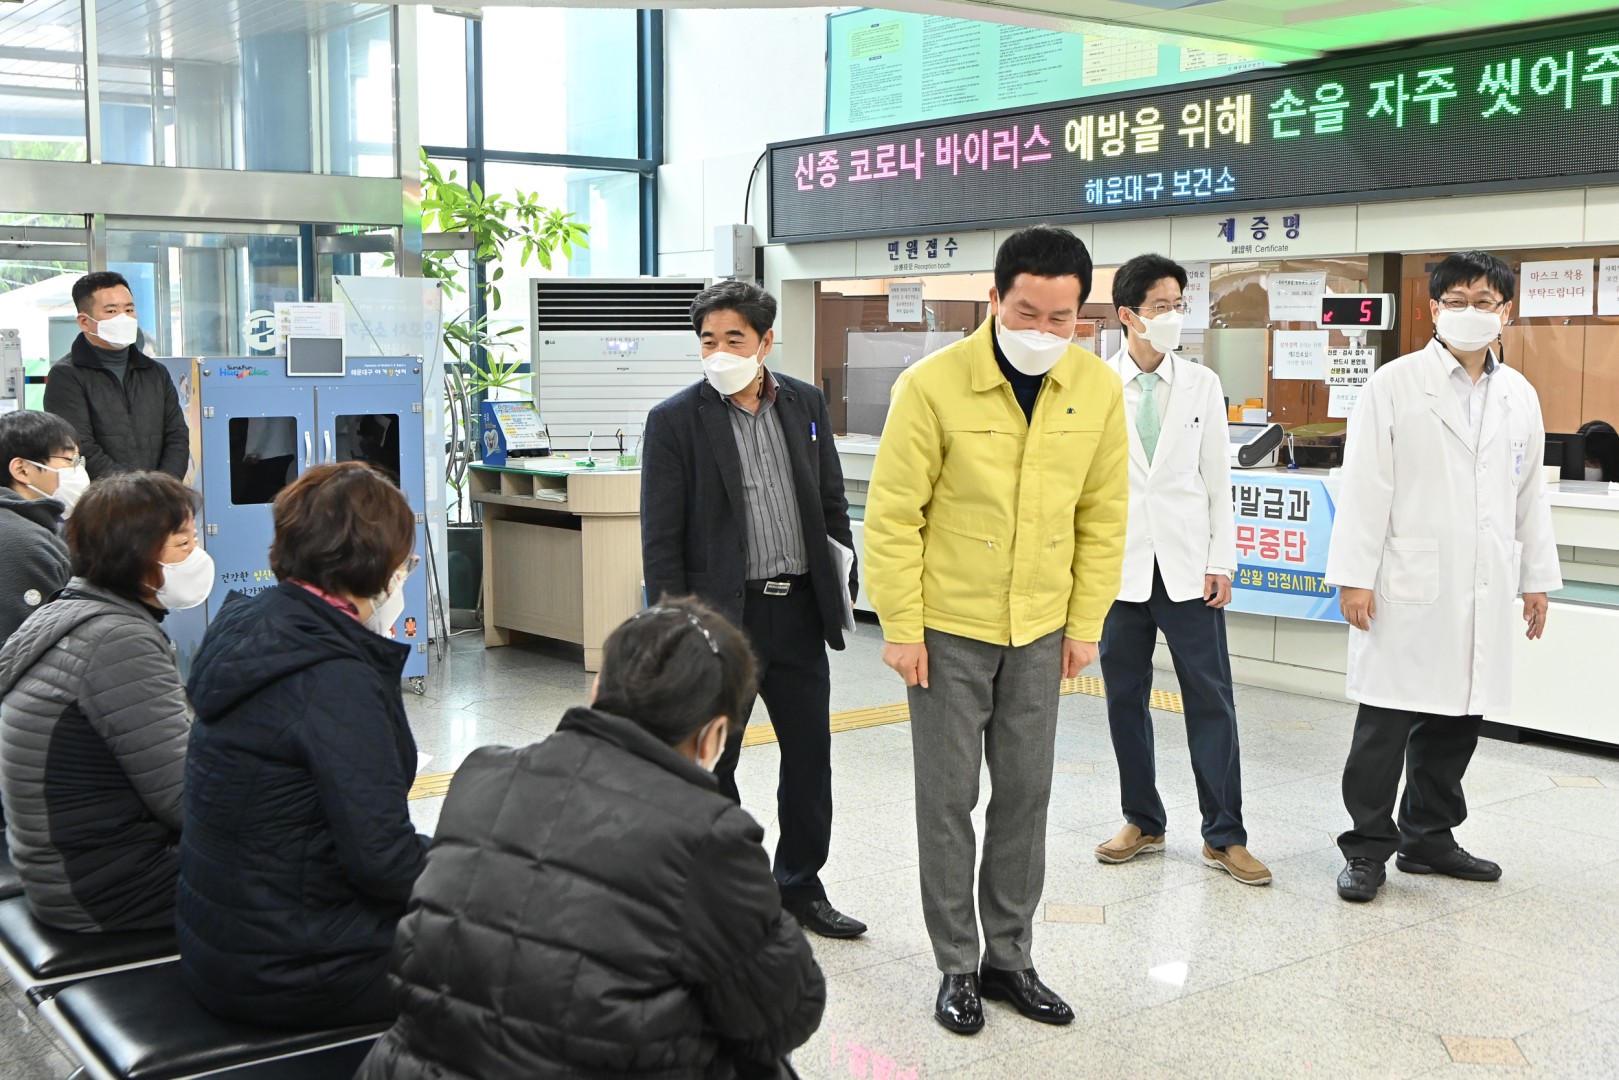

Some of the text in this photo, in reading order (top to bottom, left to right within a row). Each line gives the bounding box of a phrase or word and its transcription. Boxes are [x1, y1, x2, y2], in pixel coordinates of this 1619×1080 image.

[794, 149, 840, 191] 신종
[848, 138, 924, 182] 코로나
[936, 124, 1052, 176] 바이러스
[1064, 106, 1165, 162] 예방을
[1178, 94, 1251, 149] 위해
[1267, 82, 1350, 139] 손을
[1366, 67, 1458, 128] 자주
[1084, 166, 1236, 205] 해운대구 보건소
[888, 237, 958, 260] 민원접수
[1255, 244, 1288, 252] Certificate
[1530, 269, 1584, 282] 마스크 착용
[1528, 286, 1586, 299] 부탁드립니다
[1360, 300, 1372, 322] 5
[221, 572, 249, 584] 건강한
[1240, 568, 1263, 586] 상황
[1268, 571, 1330, 594] 안정시까지
